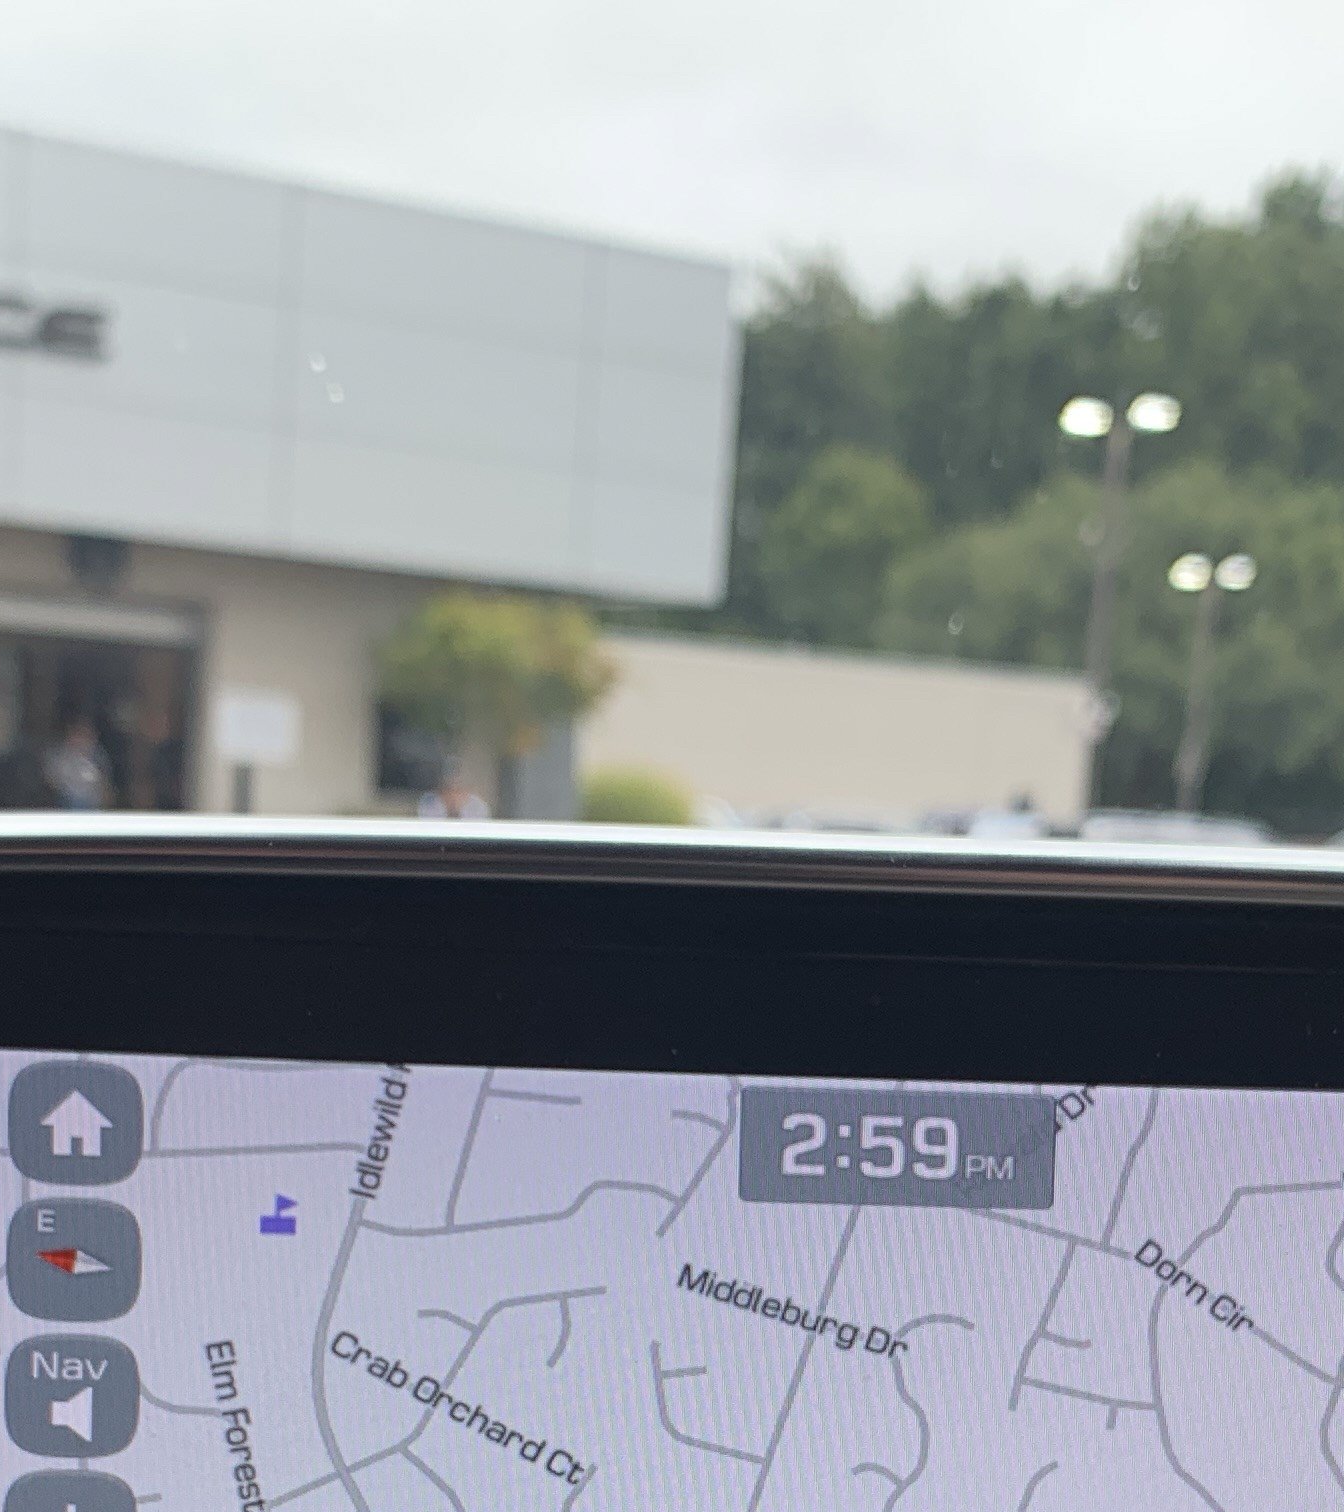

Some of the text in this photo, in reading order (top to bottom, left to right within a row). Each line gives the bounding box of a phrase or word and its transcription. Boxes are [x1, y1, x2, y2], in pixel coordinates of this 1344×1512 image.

[350, 1076, 407, 1199] Idlewild
[780, 1112, 959, 1181] 2:59
[964, 1153, 1016, 1181] PM
[36, 1209, 55, 1233] E
[677, 1263, 909, 1360] Middleburg Dr
[1134, 1239, 1255, 1333] Dorn Cir
[31, 1351, 108, 1380] Nav
[205, 1340, 237, 1403] Elm
[331, 1331, 586, 1486] Crab Orchard Ct
